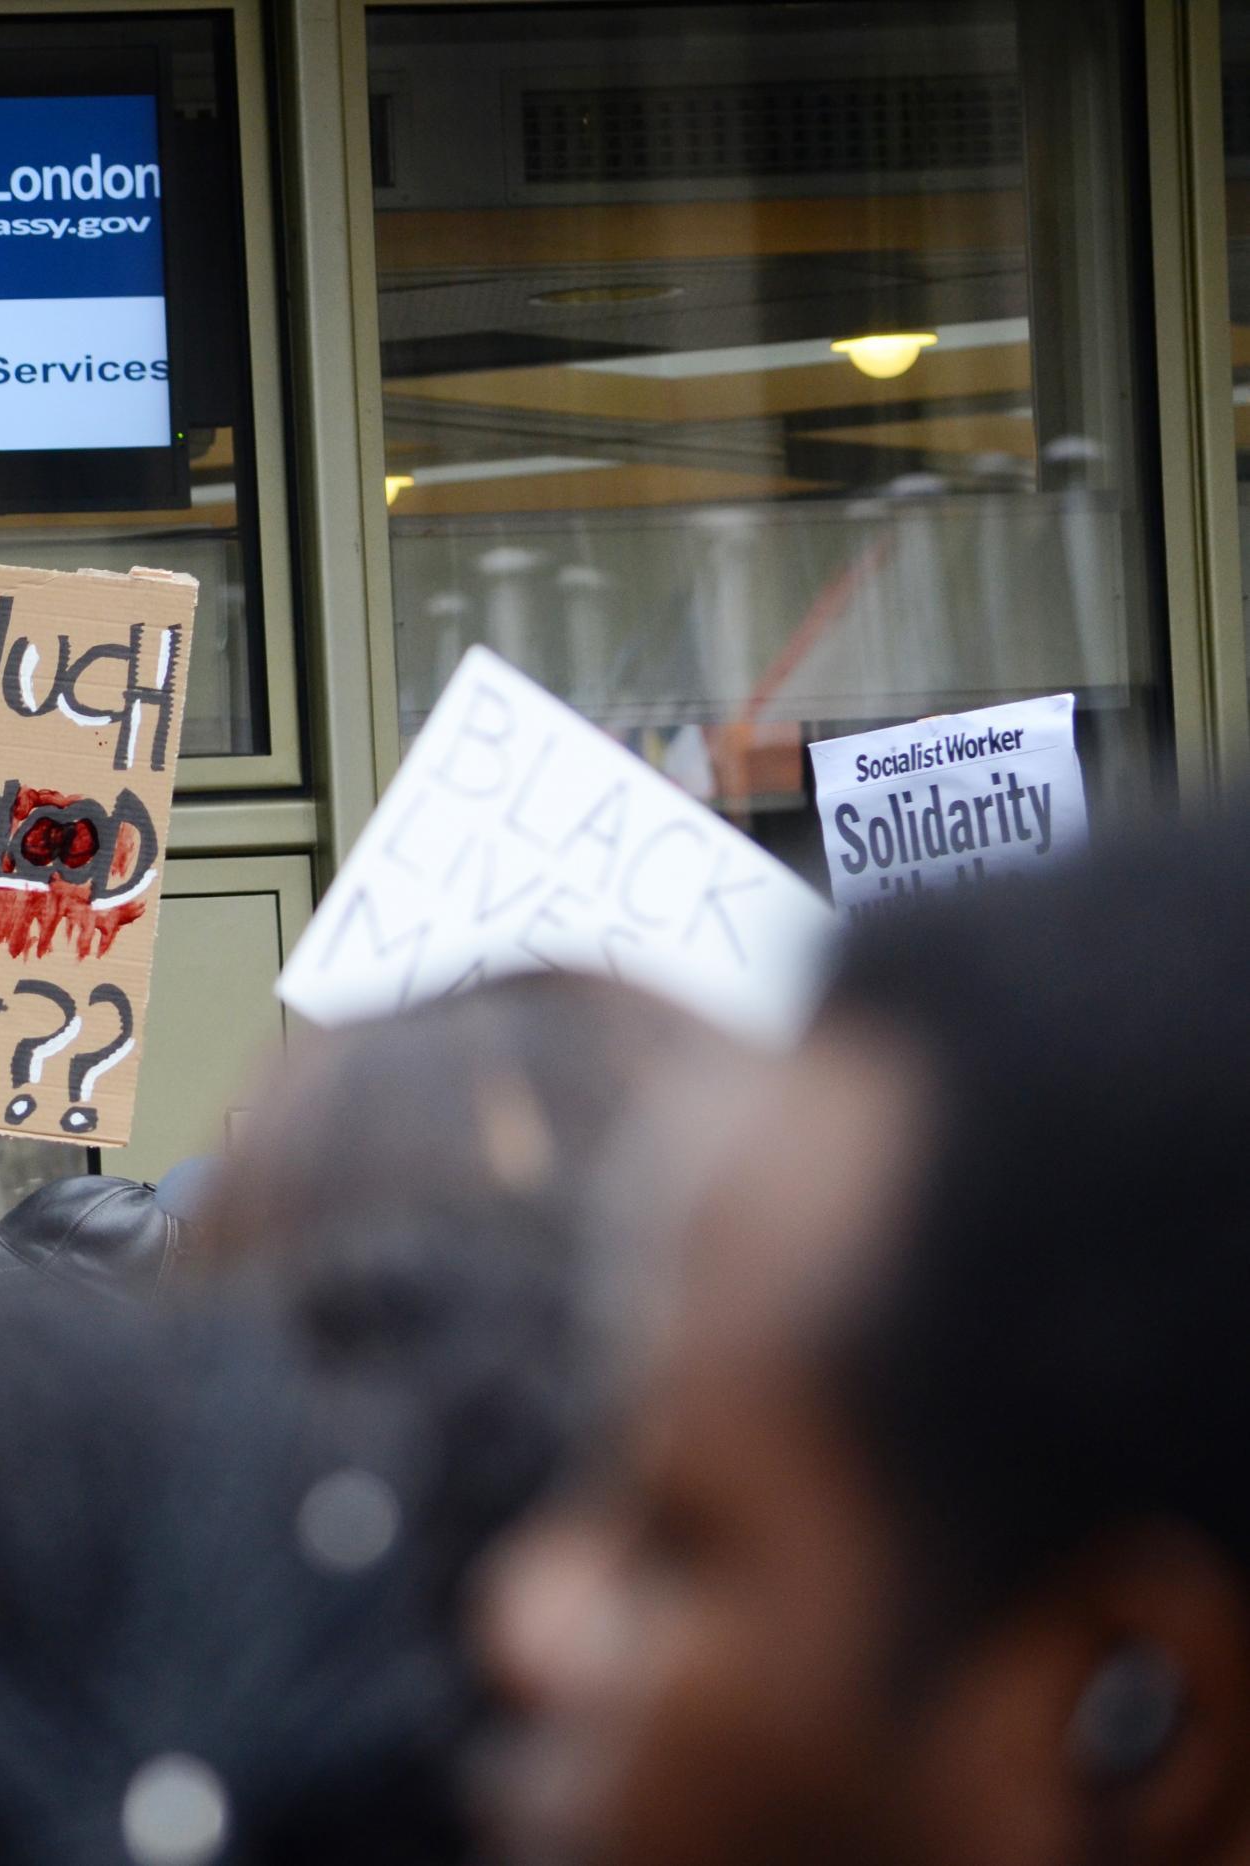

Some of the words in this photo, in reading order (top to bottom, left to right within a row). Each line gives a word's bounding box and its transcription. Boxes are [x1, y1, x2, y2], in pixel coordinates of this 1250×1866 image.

[855, 741, 945, 783] Socialist
[944, 726, 1025, 764] Worker
[425, 677, 770, 969] BLACK
[834, 771, 1052, 876] Solidarity
